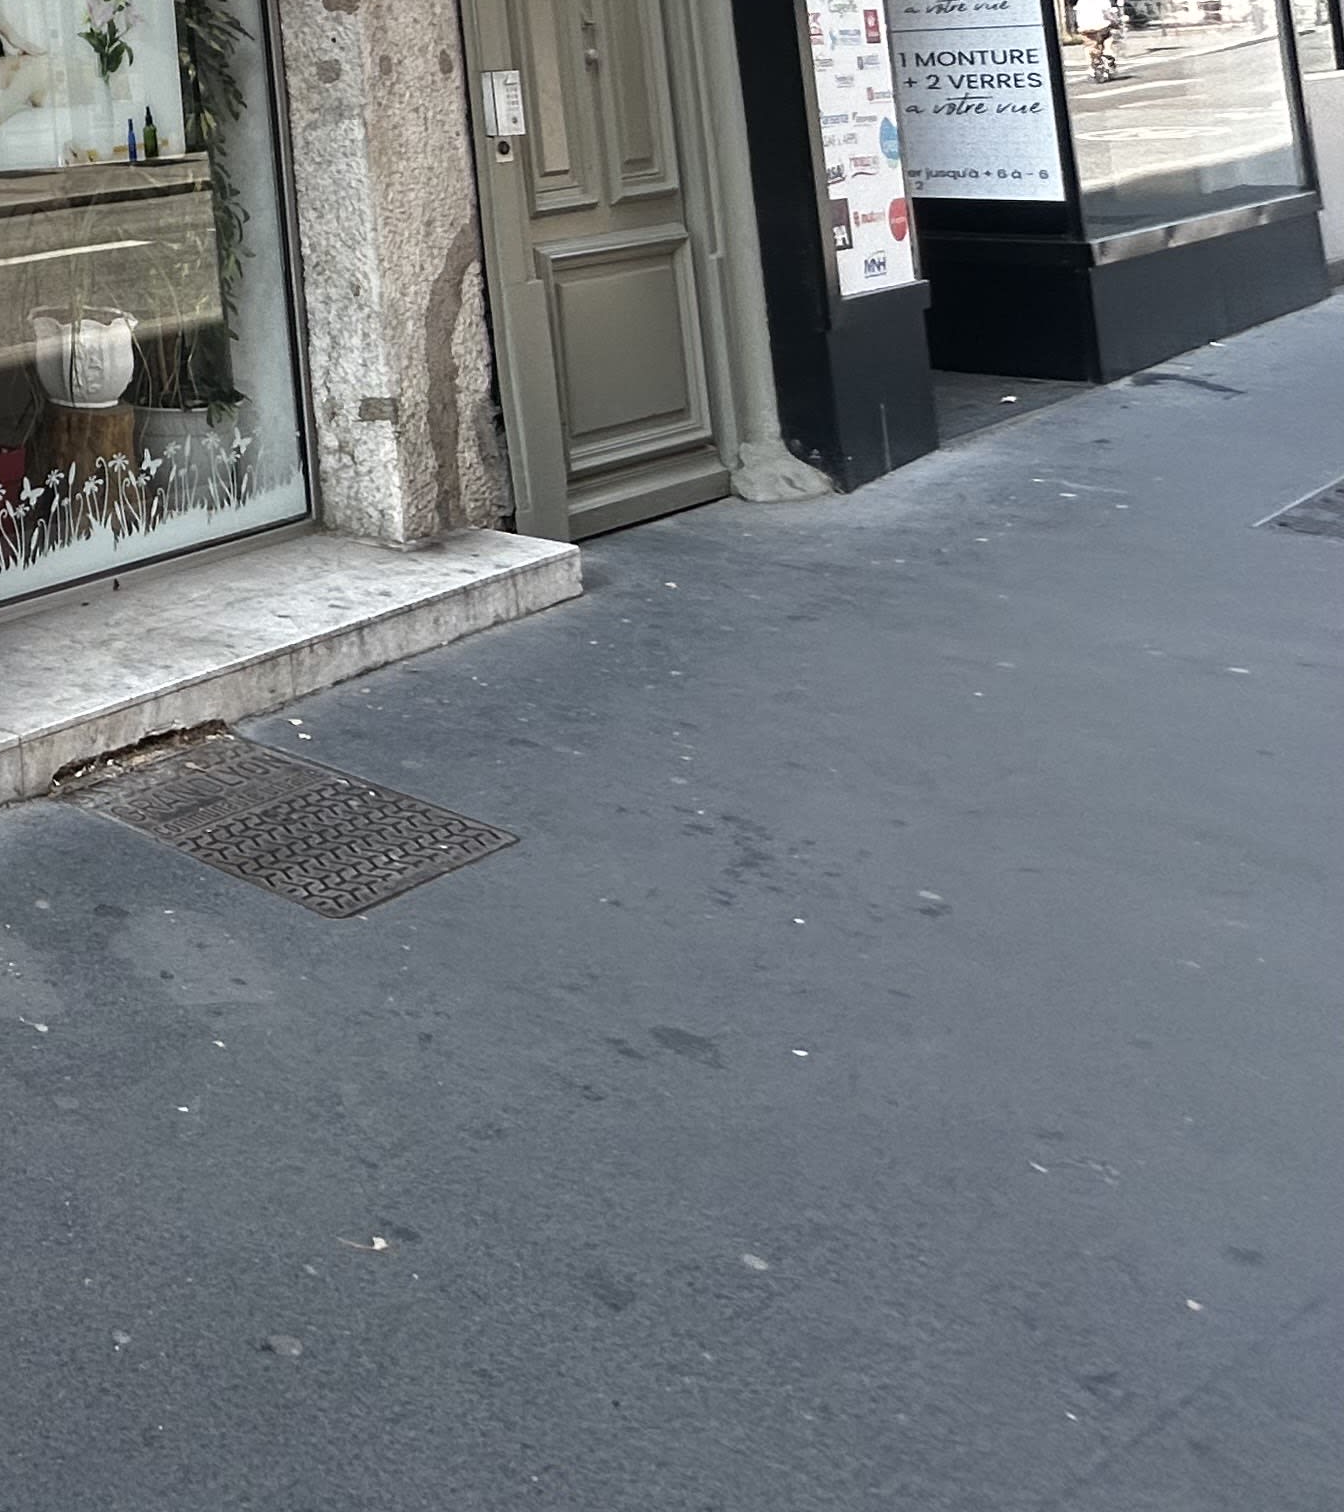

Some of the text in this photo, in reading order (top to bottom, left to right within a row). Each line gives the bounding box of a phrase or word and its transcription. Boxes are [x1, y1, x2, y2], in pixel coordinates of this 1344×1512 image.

[973, 0, 1012, 12] vue
[897, 49, 1040, 68] 1 MONTURE
[925, 74, 943, 90] 2
[947, 73, 1043, 89] VERRES
[933, 93, 993, 116] votre
[996, 101, 1045, 115] vue
